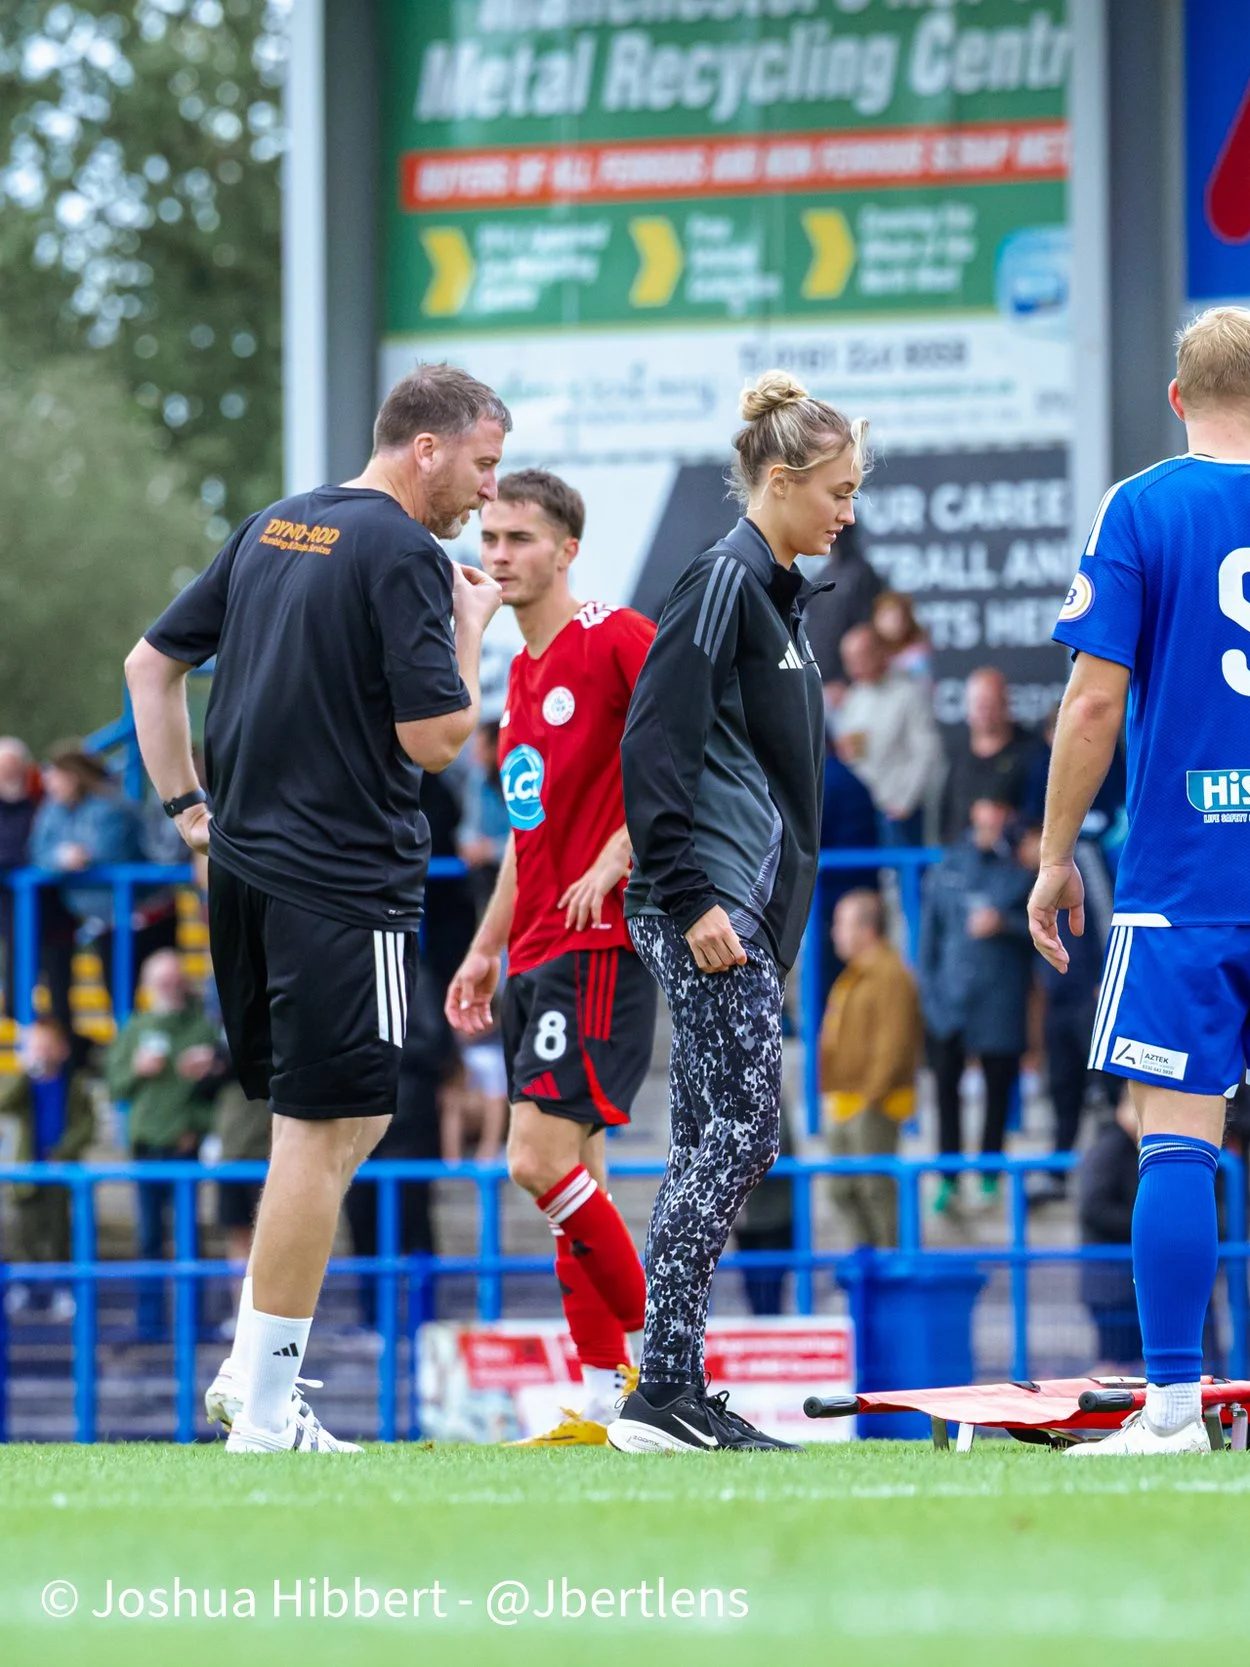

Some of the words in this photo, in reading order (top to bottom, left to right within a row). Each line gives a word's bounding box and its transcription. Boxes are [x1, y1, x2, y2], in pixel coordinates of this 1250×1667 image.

[414, 38, 598, 122] Metal
[603, 18, 898, 124] Recycling
[264, 518, 340, 545] DYNO-ROD
[533, 1010, 567, 1061] 8
[1145, 1053, 1169, 1064] AZTEK
